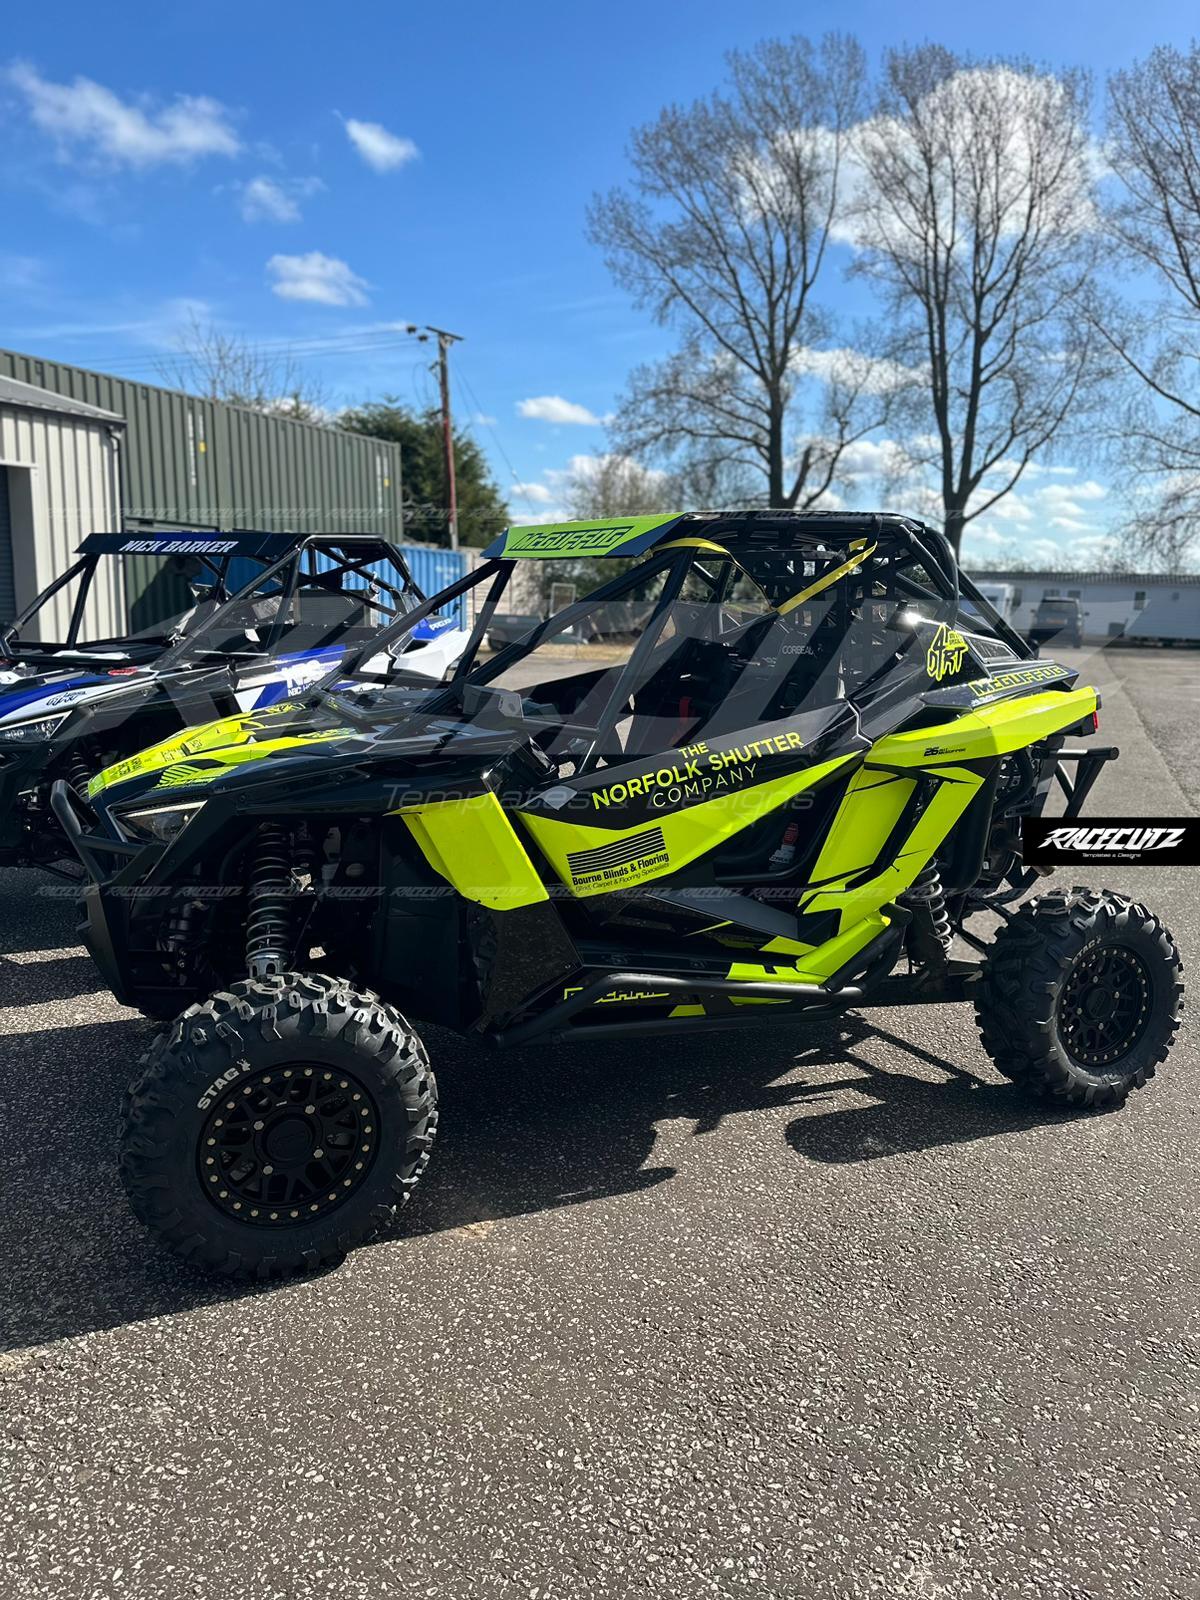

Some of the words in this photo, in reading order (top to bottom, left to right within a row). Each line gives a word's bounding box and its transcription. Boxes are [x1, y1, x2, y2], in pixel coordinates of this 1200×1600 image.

[119, 540, 167, 552] NICK
[161, 540, 239, 553] BARKER
[678, 742, 709, 759] THE
[591, 759, 703, 810] NORFOLK
[708, 731, 804, 771] SHUTTER
[652, 763, 757, 807] COMPANY
[572, 873, 602, 886] Bourne
[603, 866, 629, 880] Blinds
[630, 863, 637, 873] &
[638, 852, 670, 870] Flooring
[592, 877, 613, 890] Carpet
[619, 871, 641, 885] Flooring
[197, 1067, 240, 1110] STAG
